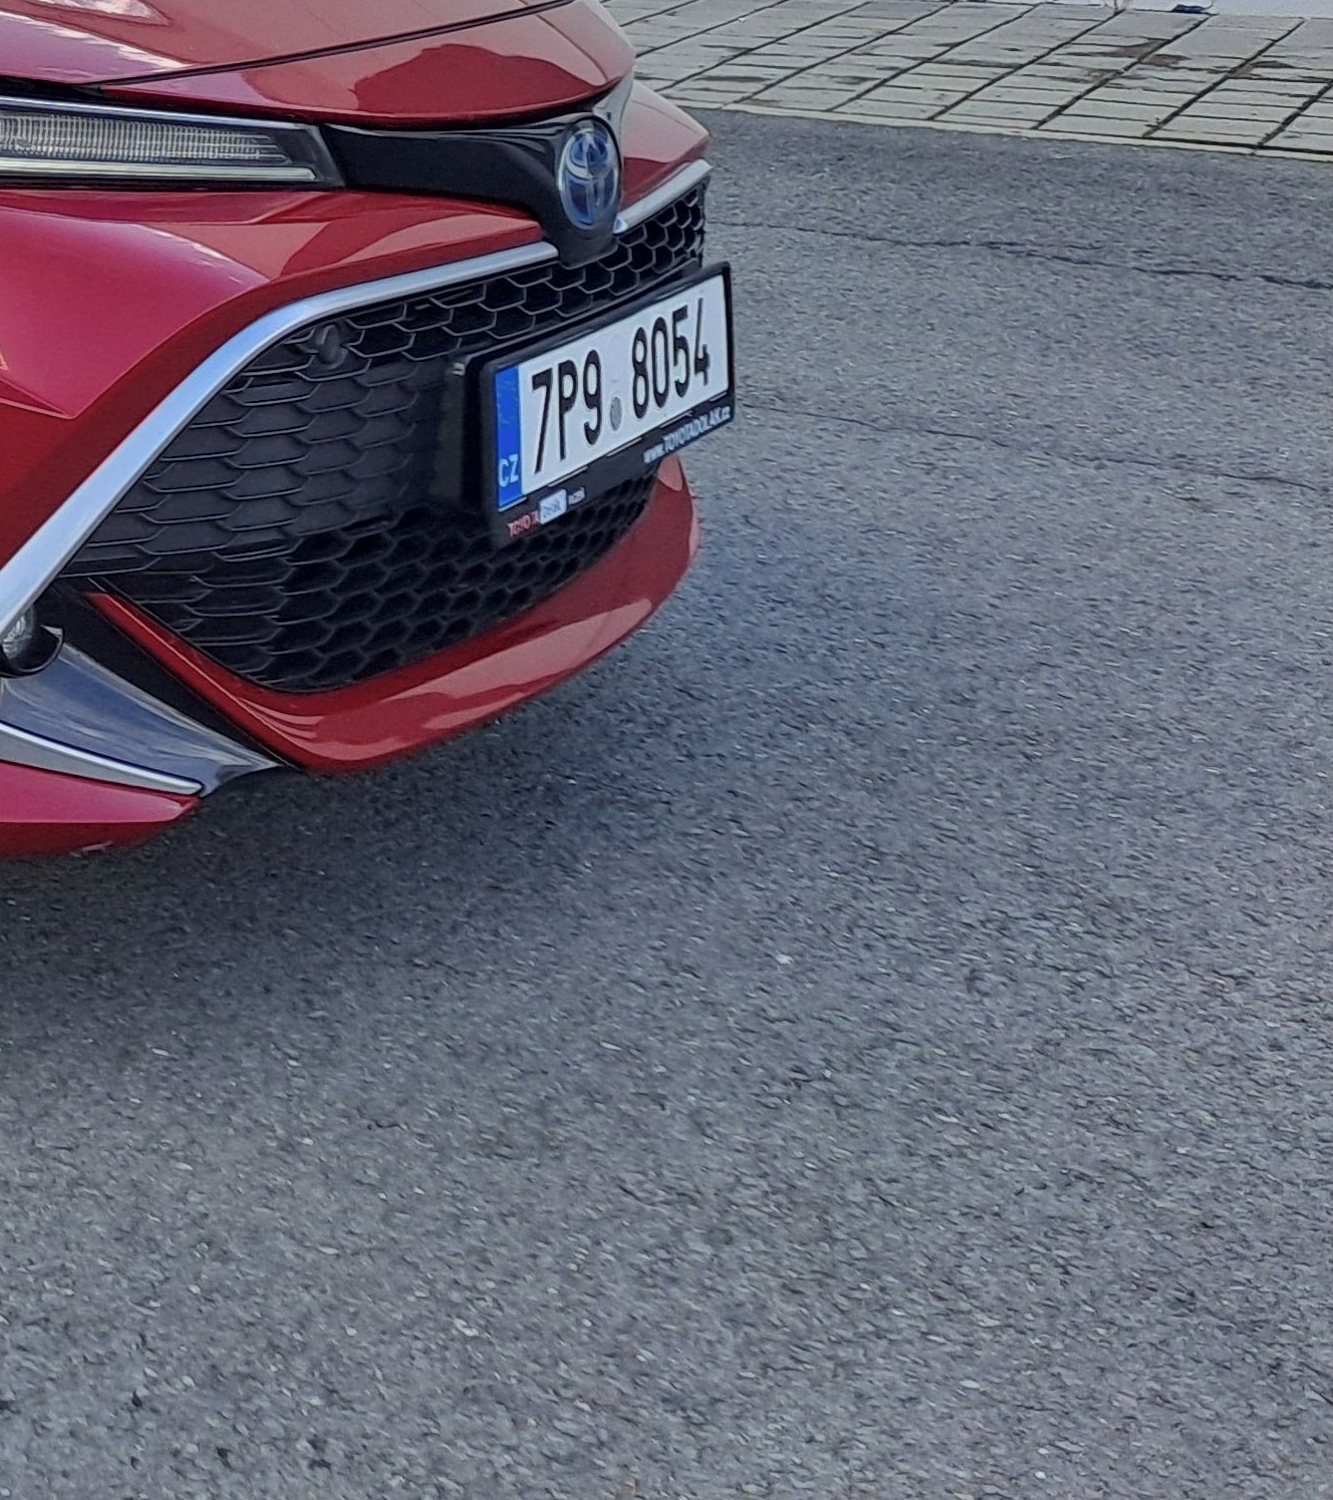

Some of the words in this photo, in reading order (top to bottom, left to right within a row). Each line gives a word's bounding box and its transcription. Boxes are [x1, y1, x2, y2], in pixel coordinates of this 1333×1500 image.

[531, 349, 603, 474] 7P9
[631, 297, 710, 419] 8054
[497, 453, 520, 488] CZ
